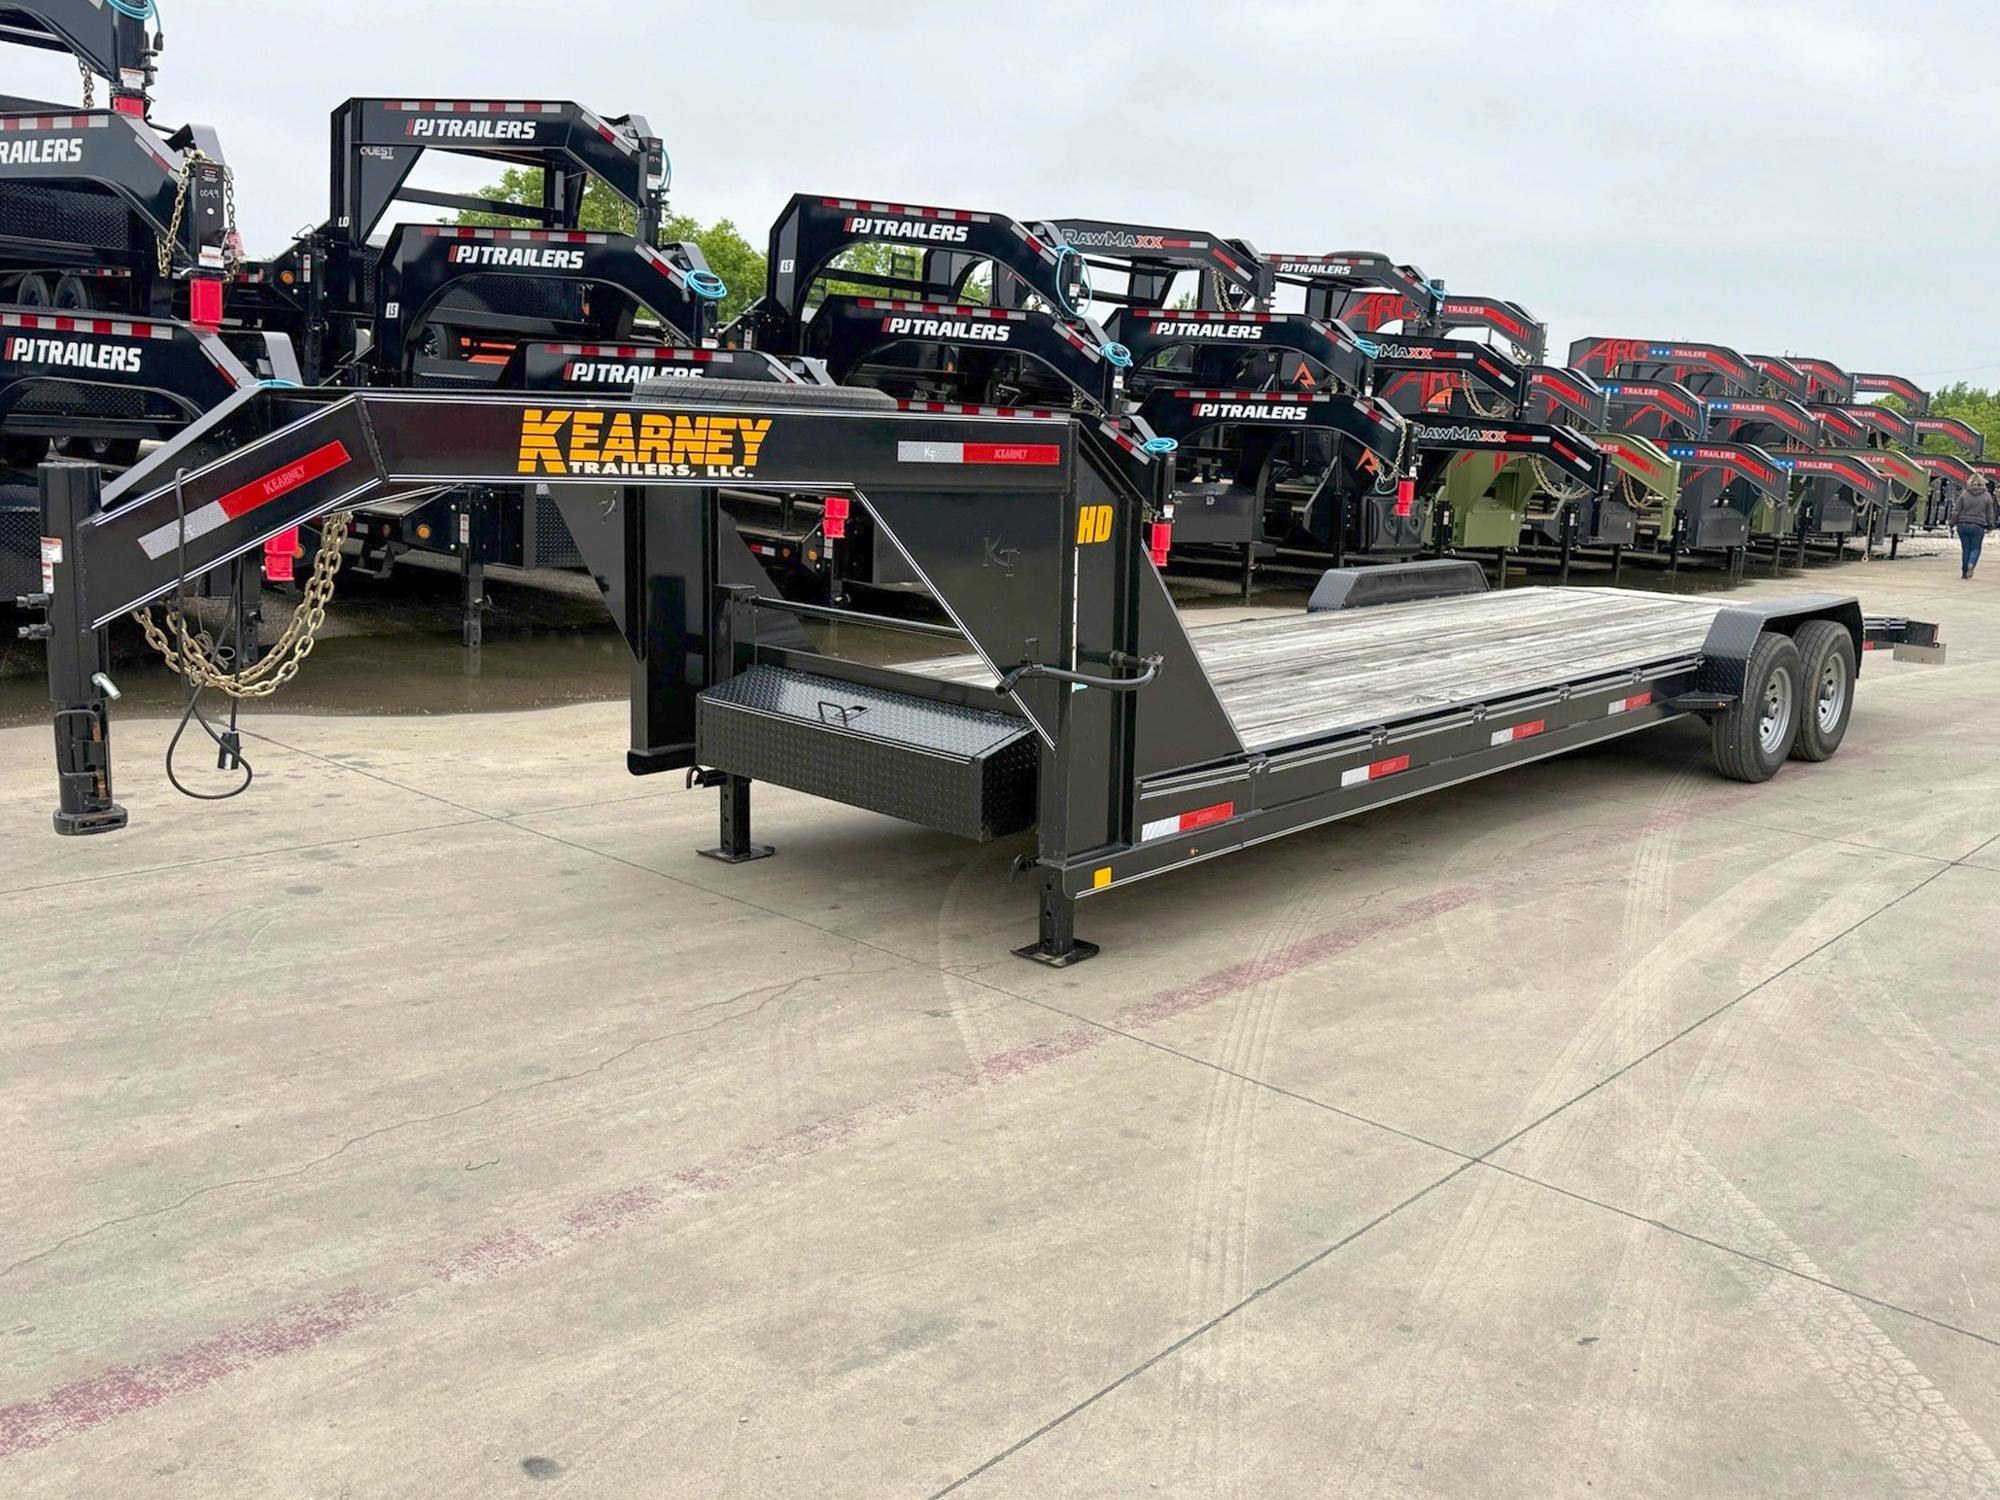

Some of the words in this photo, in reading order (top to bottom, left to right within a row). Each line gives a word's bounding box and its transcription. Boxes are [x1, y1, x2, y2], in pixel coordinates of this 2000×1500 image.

[0, 137, 83, 164] RAILERS
[1623, 387, 1659, 396] TRAILERS
[518, 408, 772, 474] KEARNEY
[1699, 450, 1736, 459] TRAILERS
[1798, 460, 1833, 469] TRAILERS
[262, 465, 306, 494] KEARNEY
[707, 464, 754, 478] LLC.
[1077, 505, 1113, 544] HD
